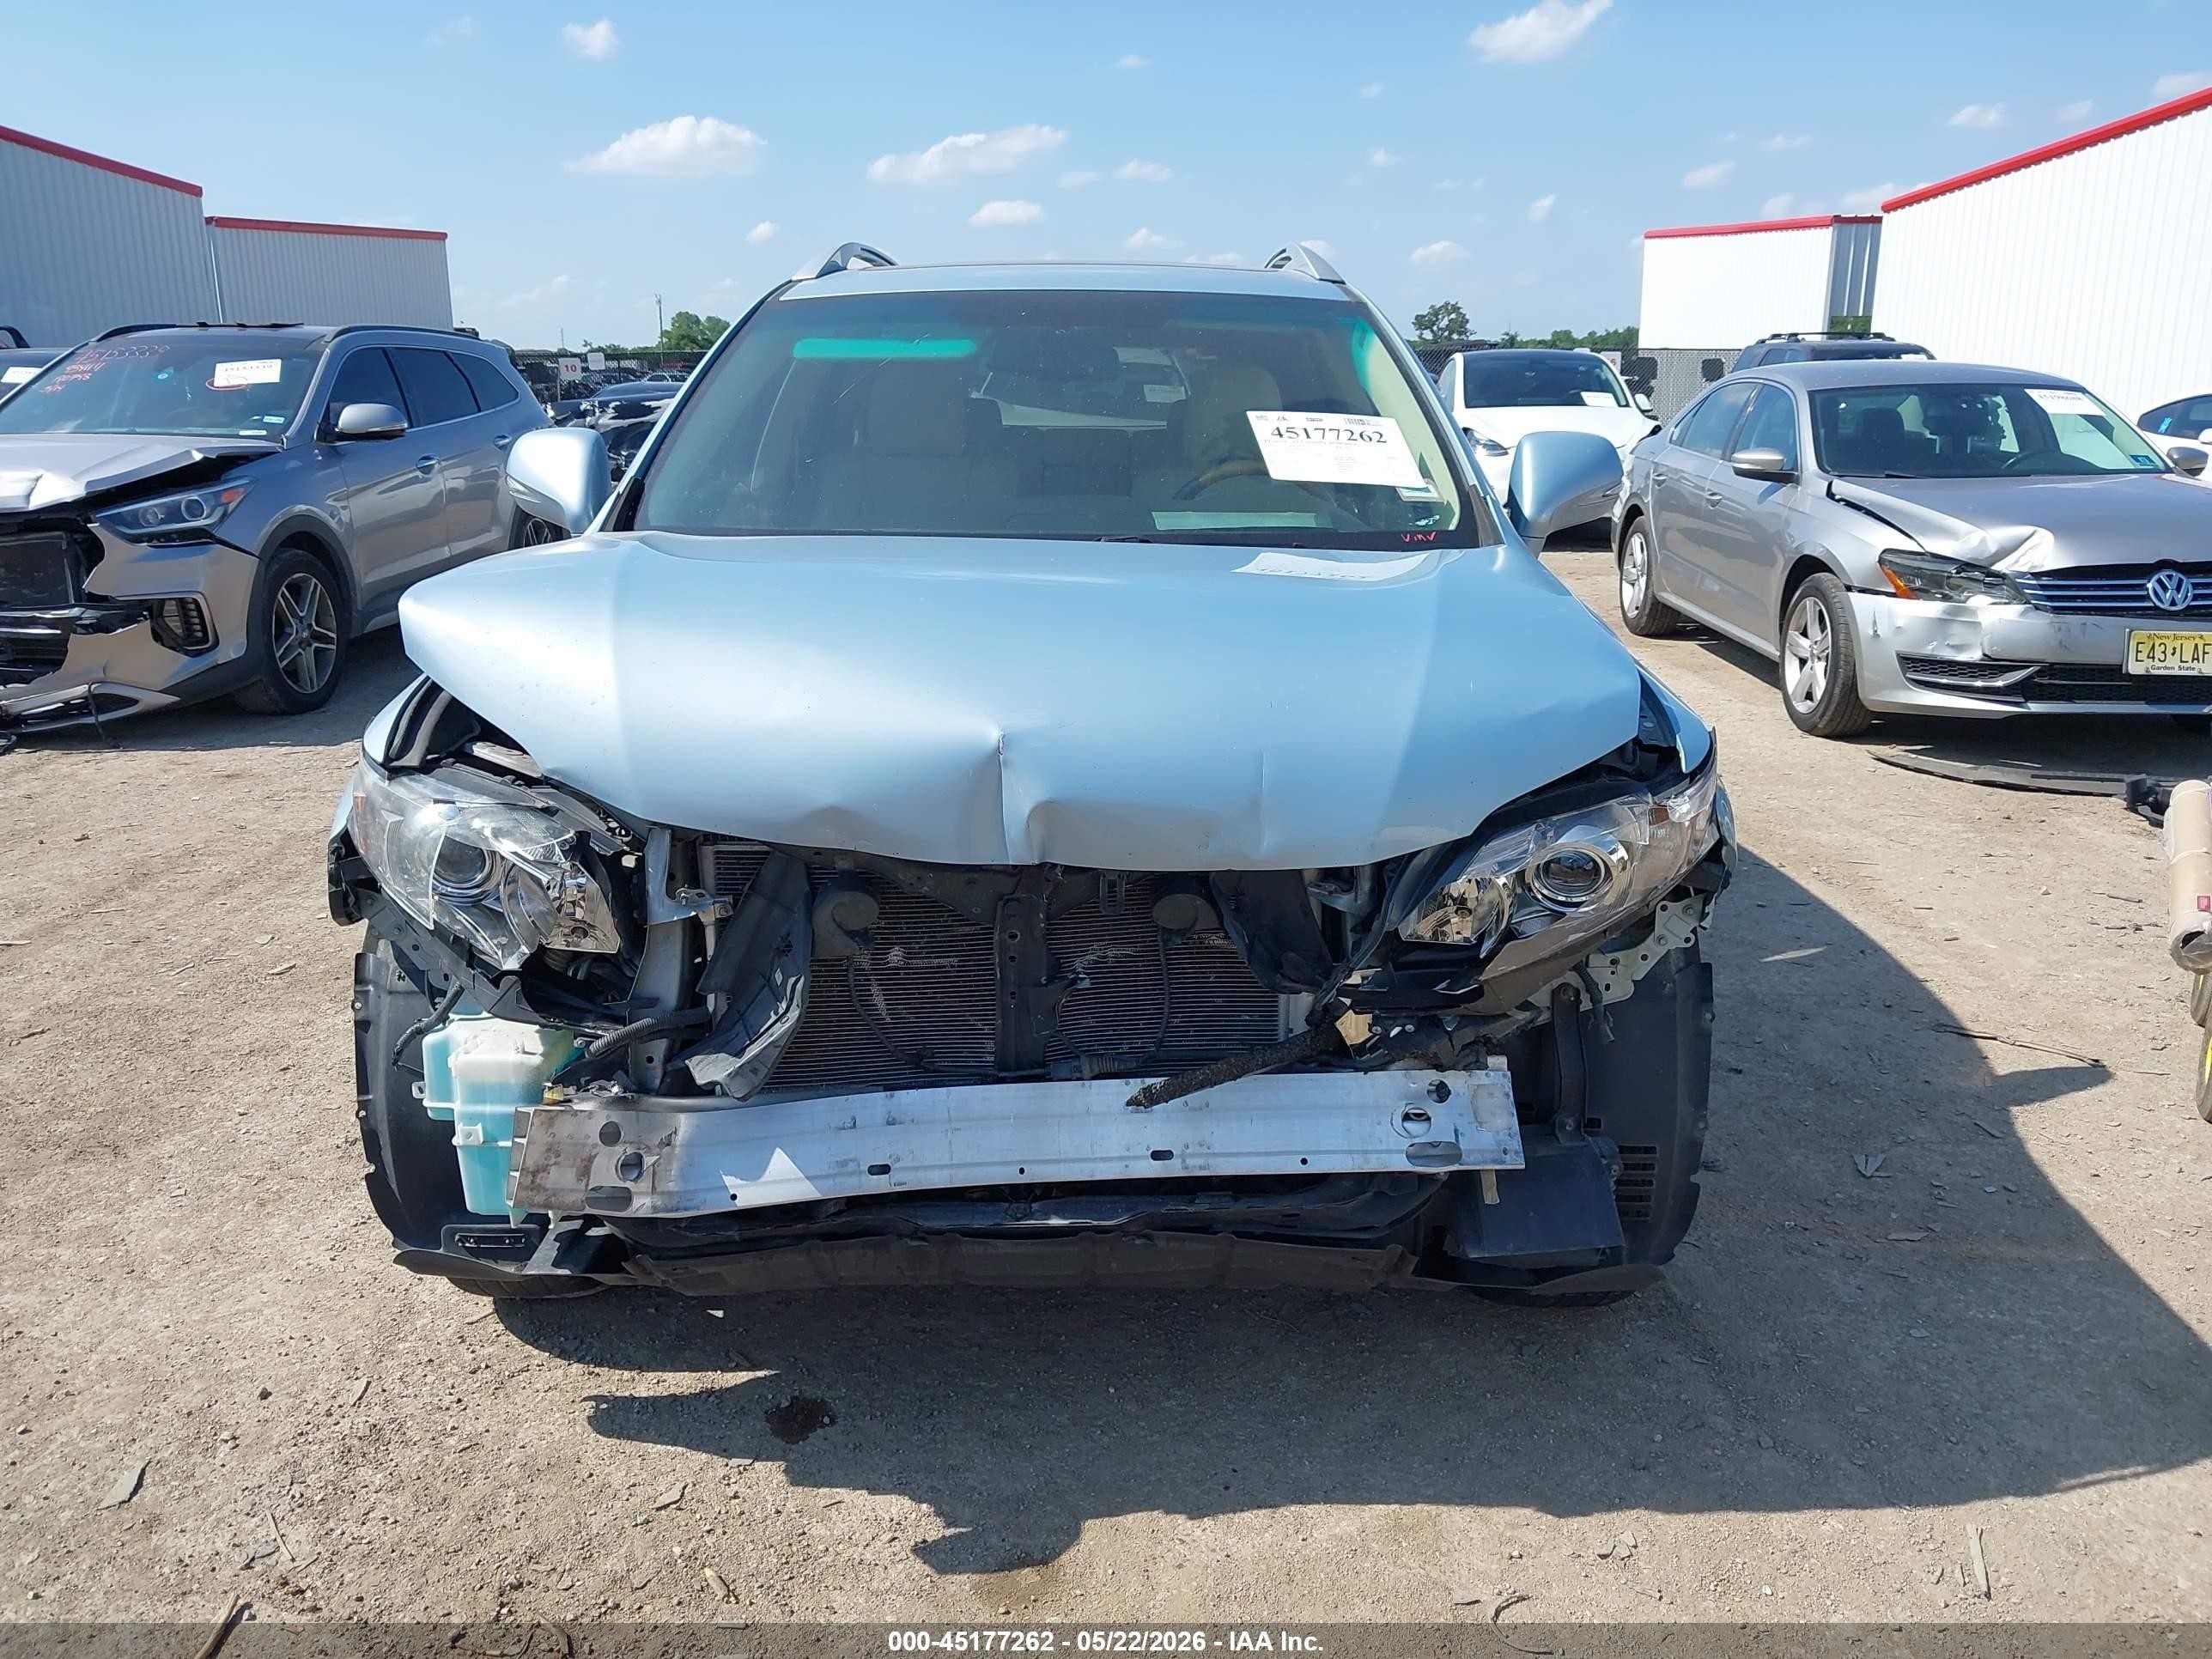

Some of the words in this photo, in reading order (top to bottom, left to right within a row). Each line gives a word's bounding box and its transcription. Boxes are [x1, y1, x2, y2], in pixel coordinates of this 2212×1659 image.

[563, 363, 577, 373] 10
[1271, 426, 1388, 444] 45177262
[2153, 632, 2172, 641] New
[2172, 633, 2197, 641] Jersey
[2135, 641, 2167, 663] E43
